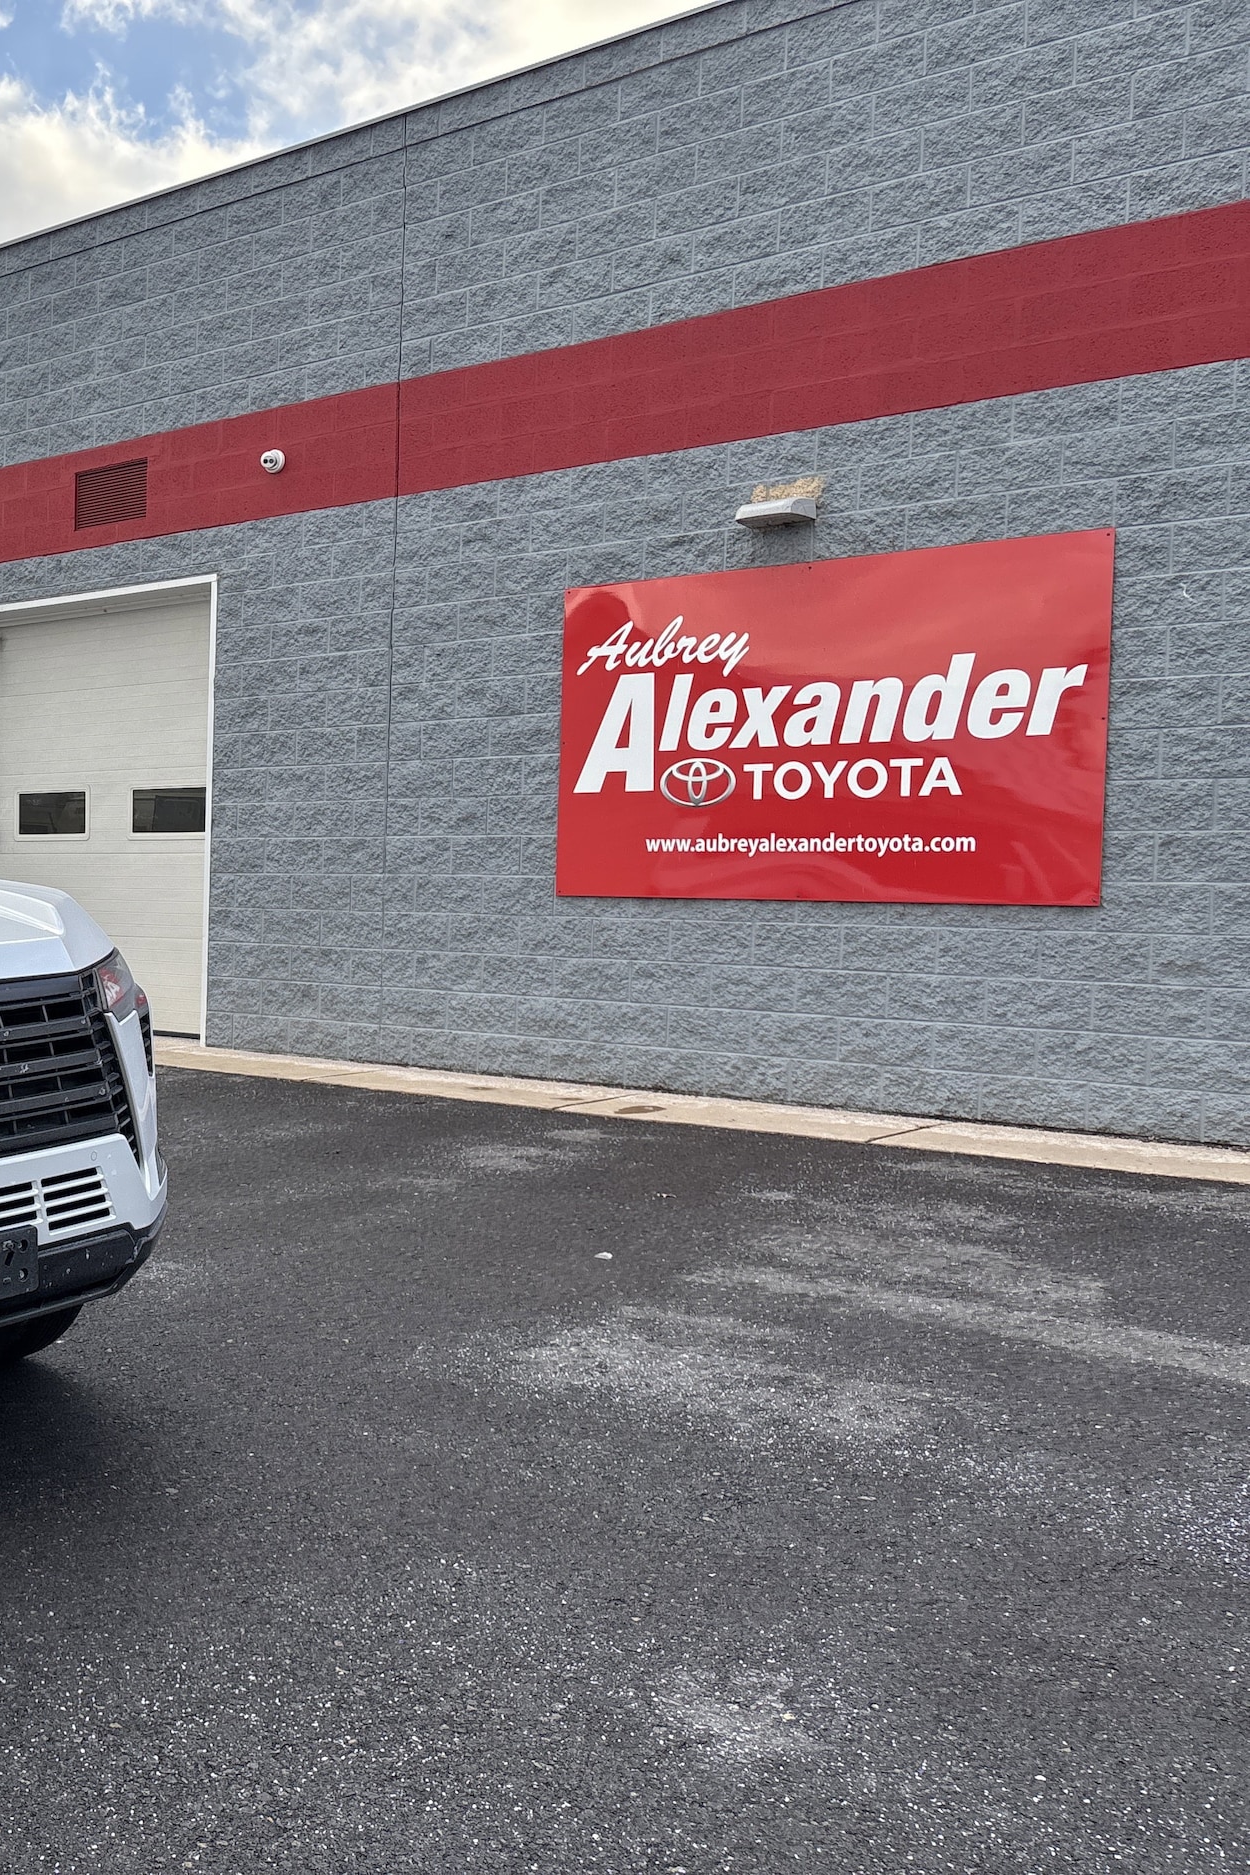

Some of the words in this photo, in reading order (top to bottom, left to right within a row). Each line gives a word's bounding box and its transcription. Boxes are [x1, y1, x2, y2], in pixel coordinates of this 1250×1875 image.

[576, 614, 750, 677] Aubrey
[573, 652, 1088, 794] Alexander
[743, 756, 963, 801] TOYOTA
[645, 832, 976, 858] www.aubreyalexandertoyota.com
